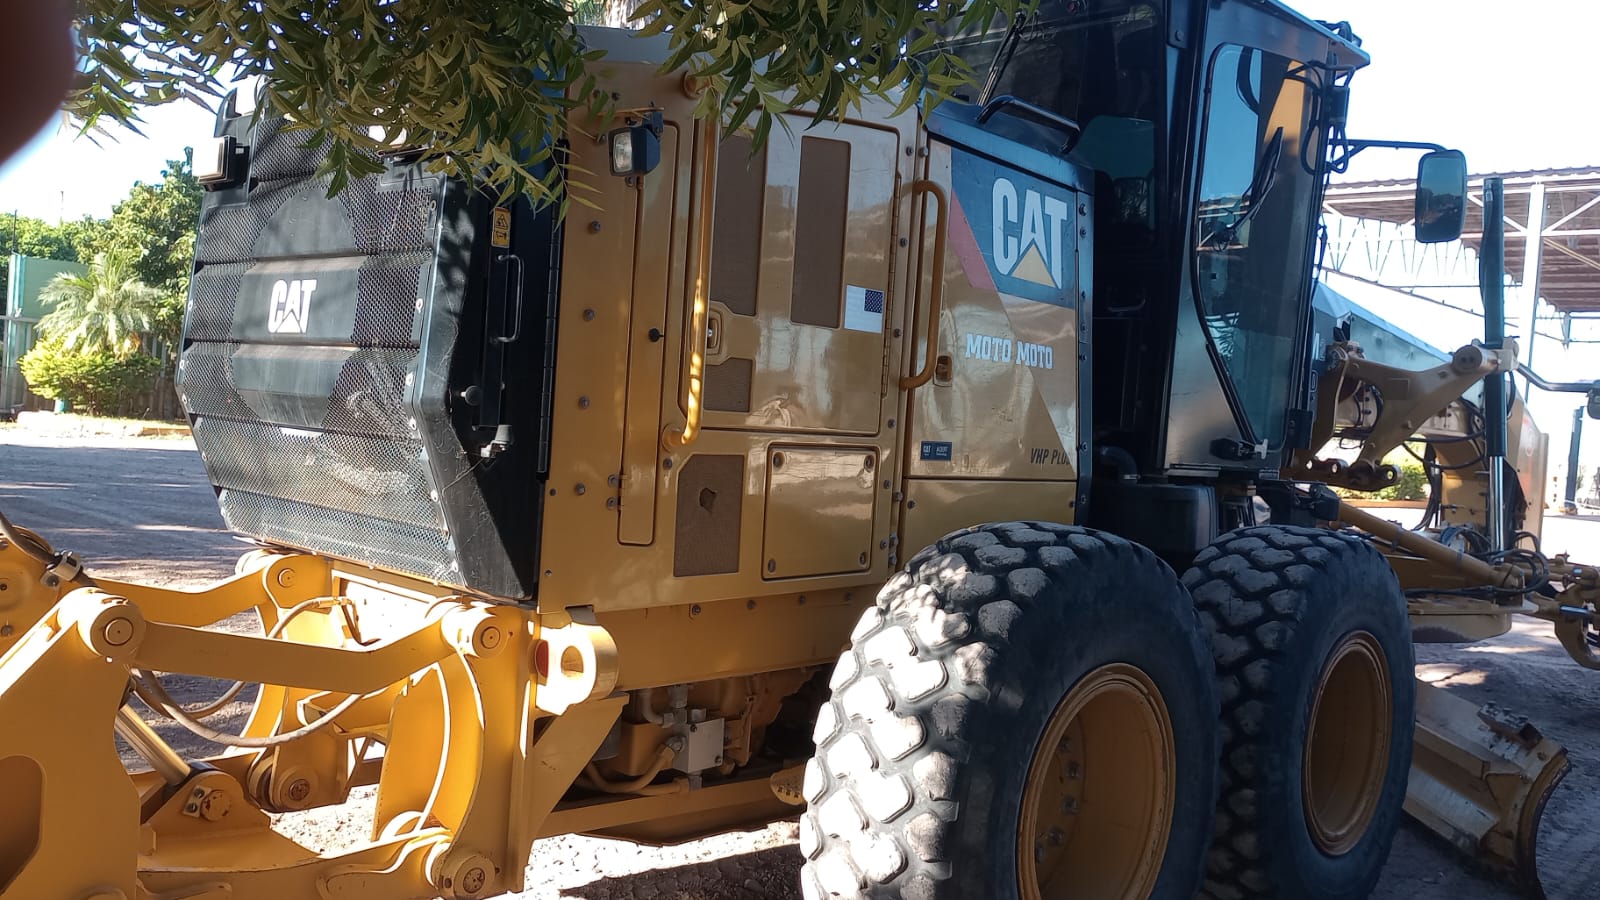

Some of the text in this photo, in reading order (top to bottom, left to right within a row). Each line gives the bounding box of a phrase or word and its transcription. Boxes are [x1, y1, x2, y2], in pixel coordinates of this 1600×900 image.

[992, 178, 1067, 289] CAT
[268, 280, 317, 333] CAT
[965, 333, 1053, 369] MOTO MOTO
[1030, 448, 1071, 464] VHP PLU
